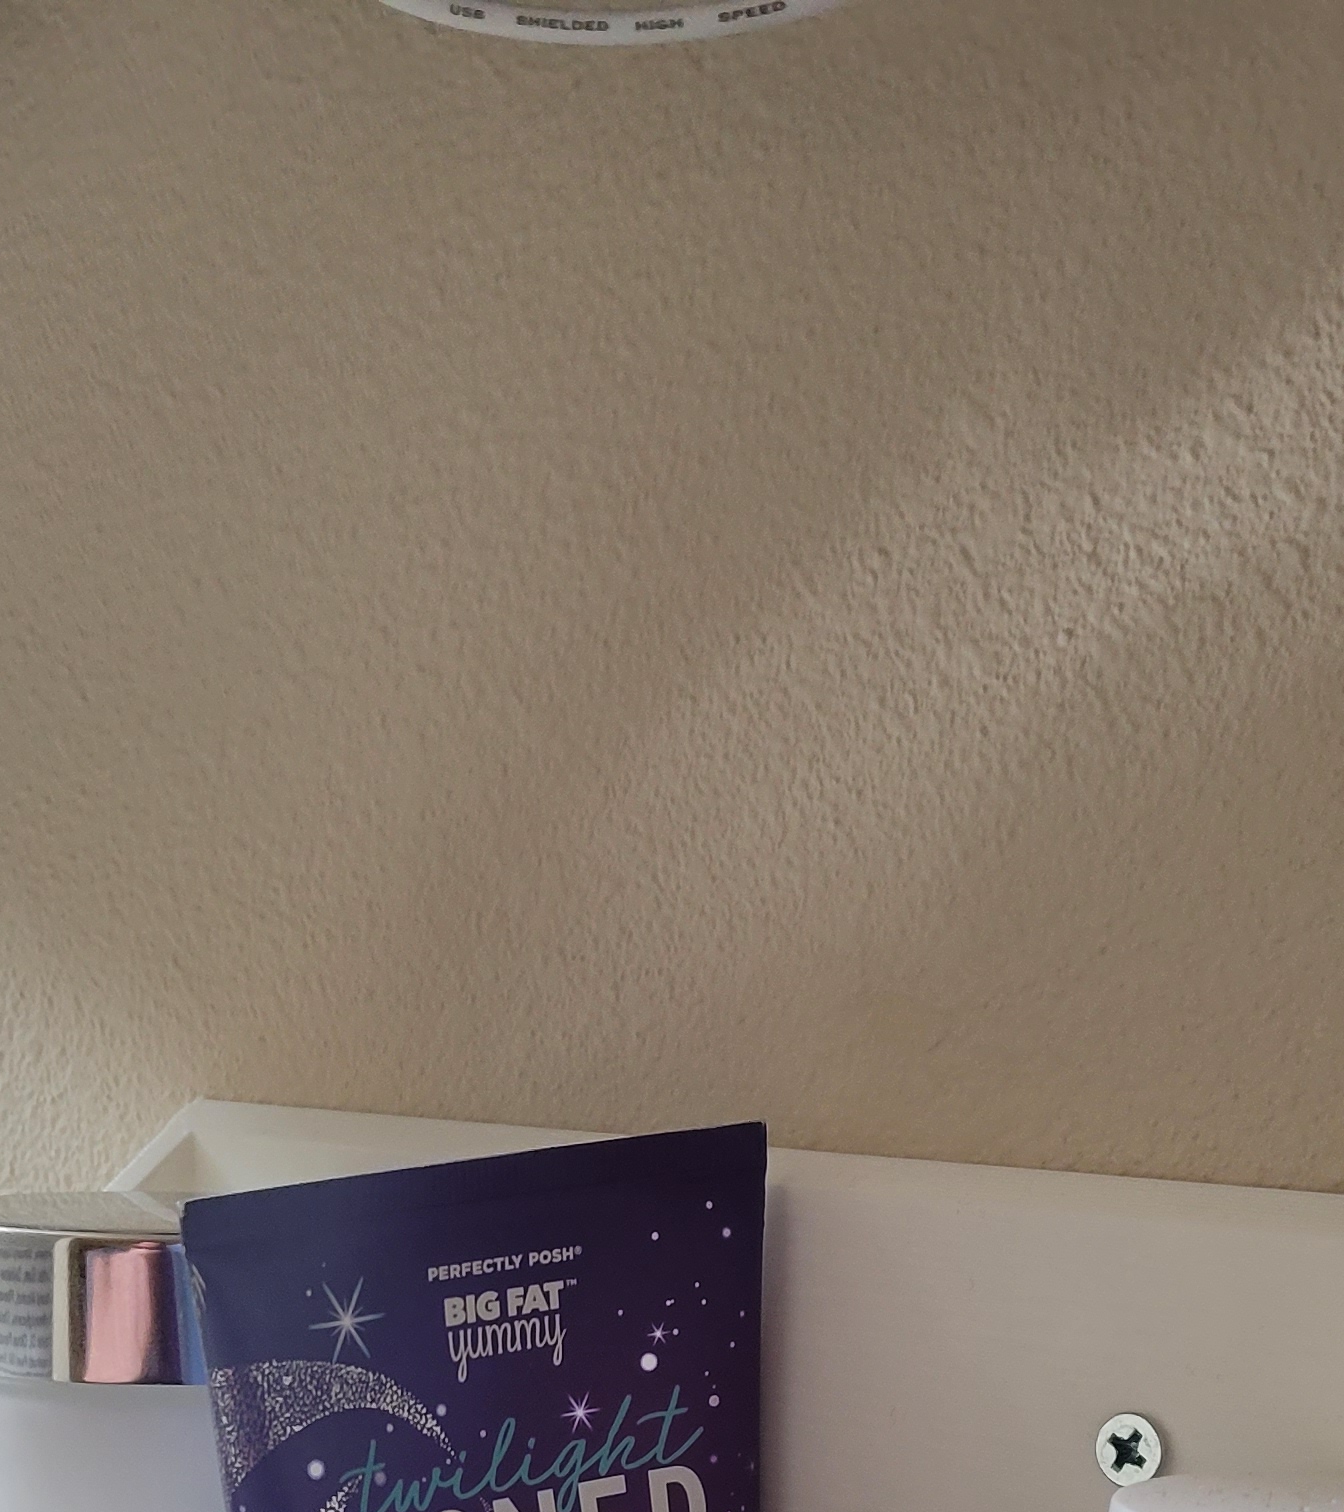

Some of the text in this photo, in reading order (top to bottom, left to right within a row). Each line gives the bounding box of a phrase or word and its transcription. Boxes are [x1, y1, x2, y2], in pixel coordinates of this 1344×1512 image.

[450, 1, 787, 33] USB SHIELDED HIGH SPEED
[427, 1253, 523, 1282] PERFECTLY
[443, 1290, 501, 1328] BIG
[447, 1313, 568, 1383] yummy
